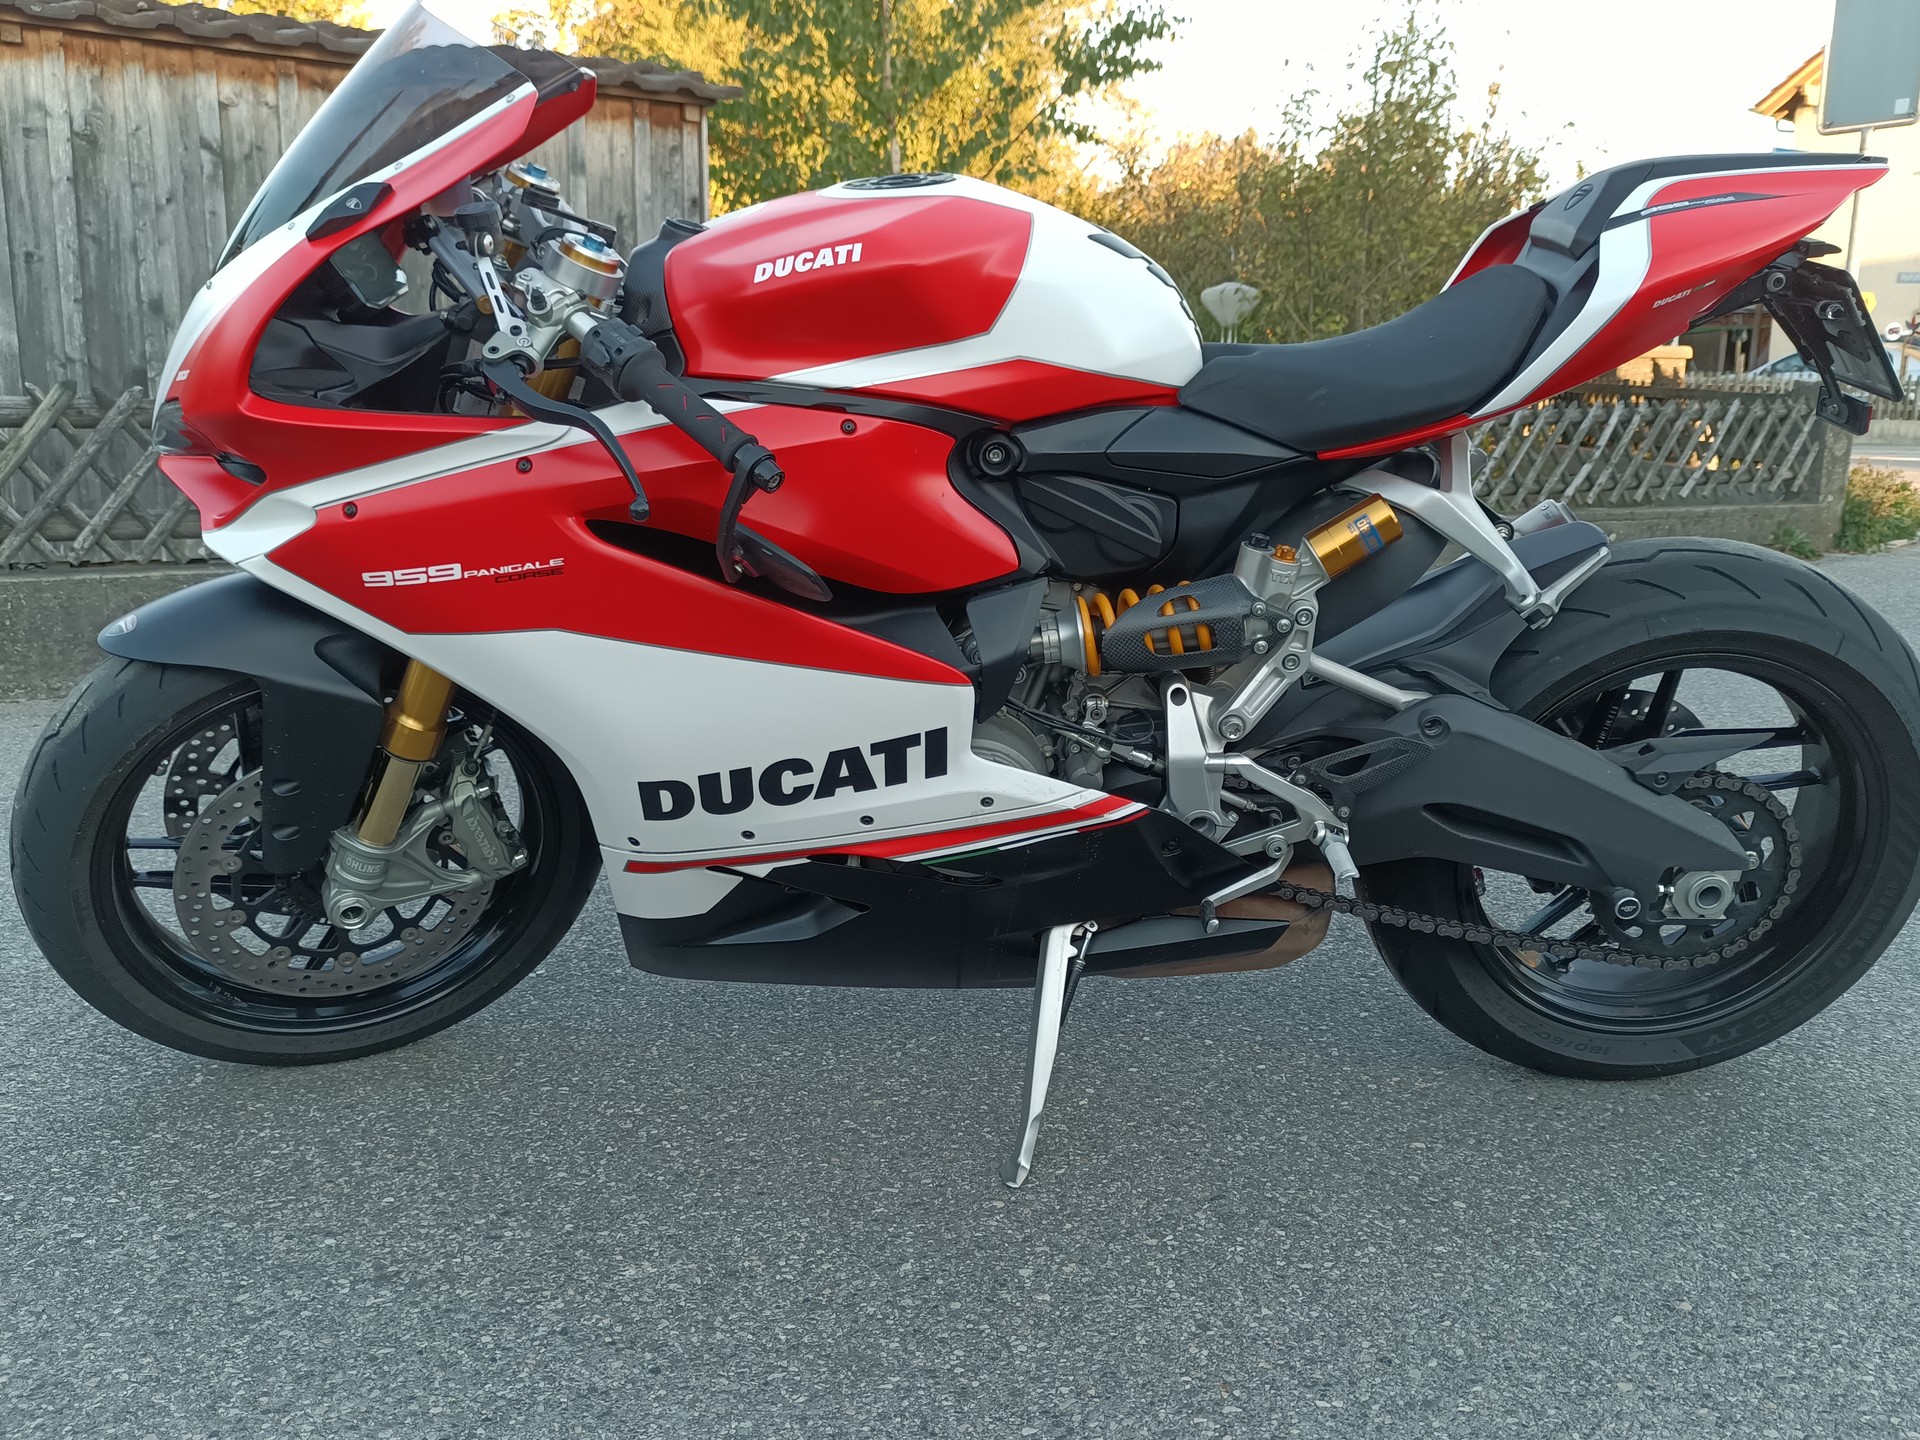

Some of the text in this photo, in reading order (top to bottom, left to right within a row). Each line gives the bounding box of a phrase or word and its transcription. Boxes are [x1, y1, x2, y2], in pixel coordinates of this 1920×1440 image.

[753, 243, 863, 284] DUCATI
[1652, 288, 1693, 309] DUCATI
[361, 557, 565, 587] 959 PANIGALE
[494, 567, 565, 584] CORSE
[637, 726, 948, 821] DUCATI
[466, 815, 499, 866] brembo
